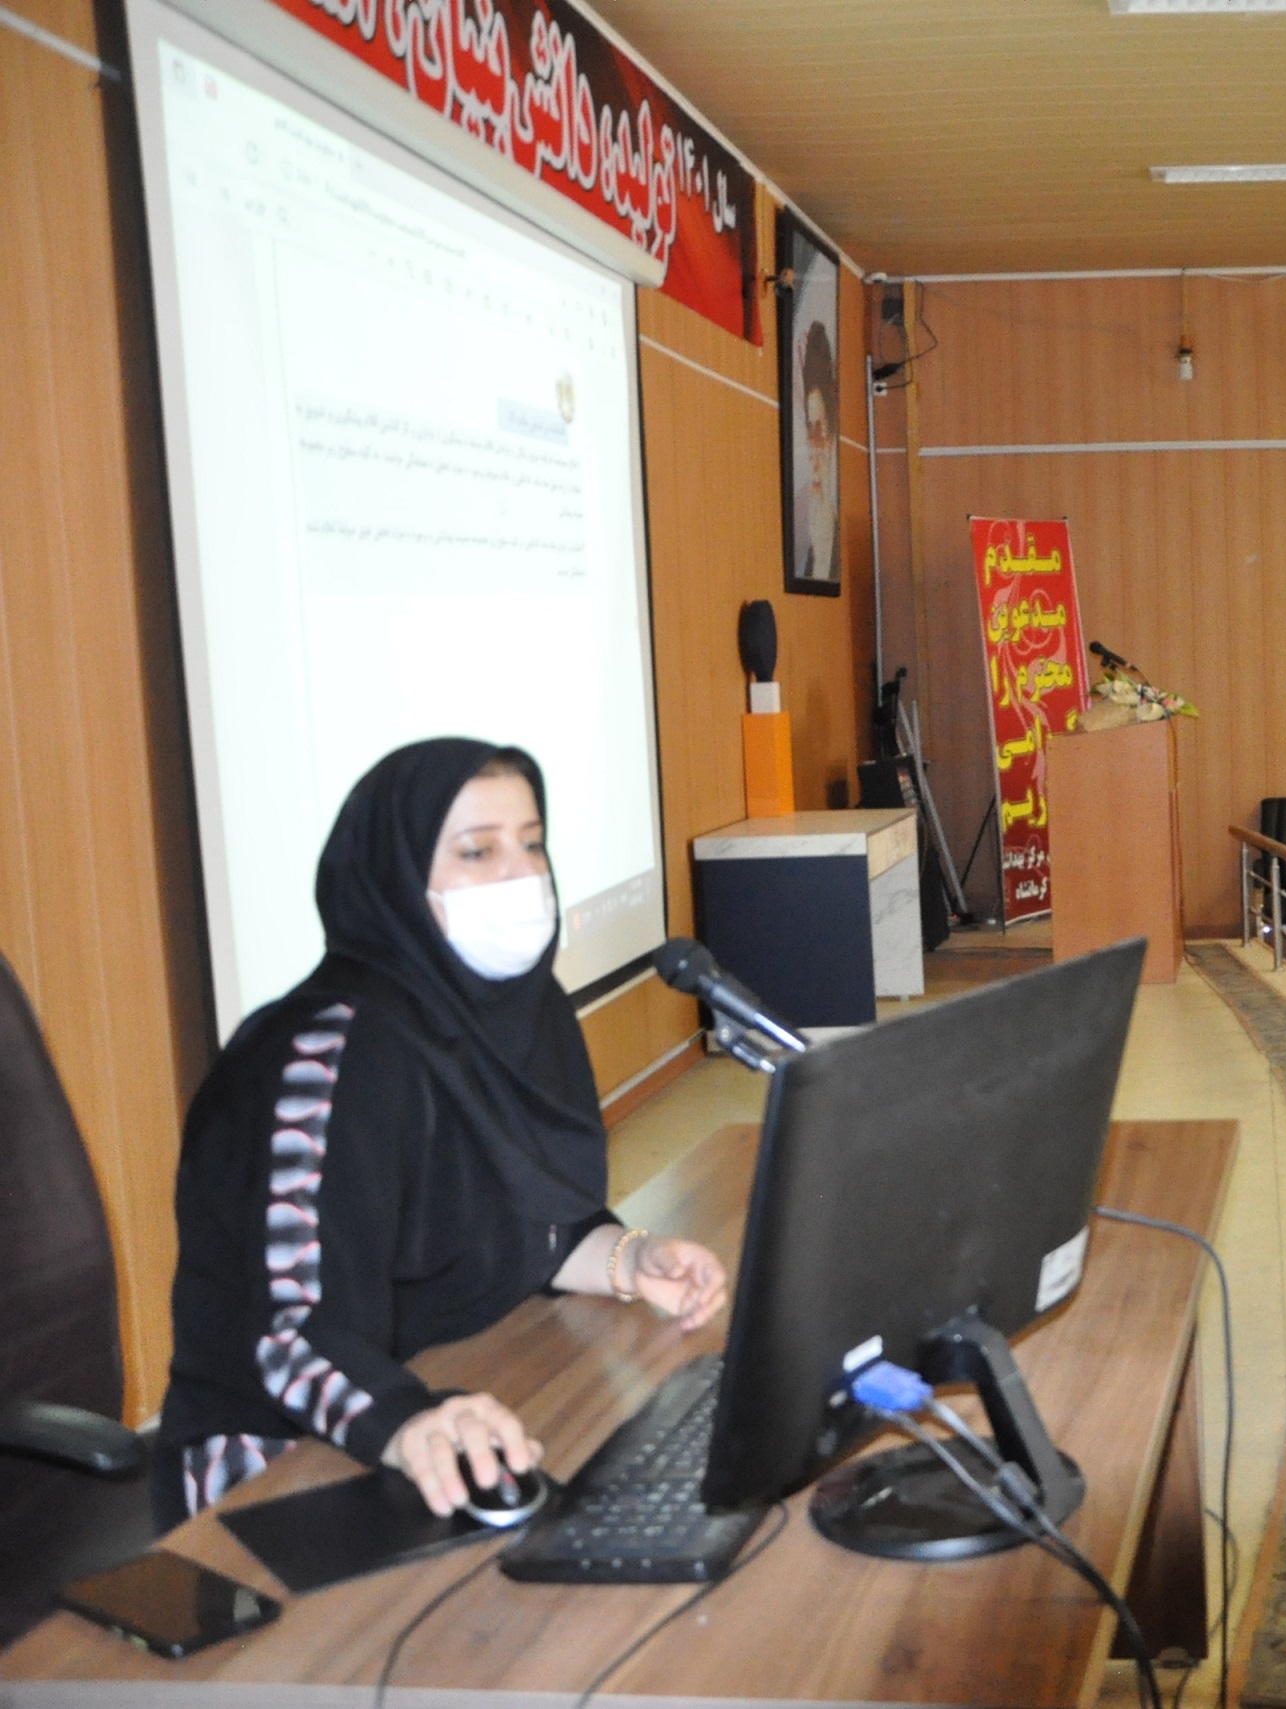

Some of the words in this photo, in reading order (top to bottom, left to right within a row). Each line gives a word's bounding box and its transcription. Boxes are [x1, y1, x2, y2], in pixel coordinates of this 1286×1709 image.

[983, 533, 1063, 586] مقدم
[986, 598, 1068, 644] مدعوین
[990, 655, 1011, 706] را
[1015, 656, 1074, 704] محترم
